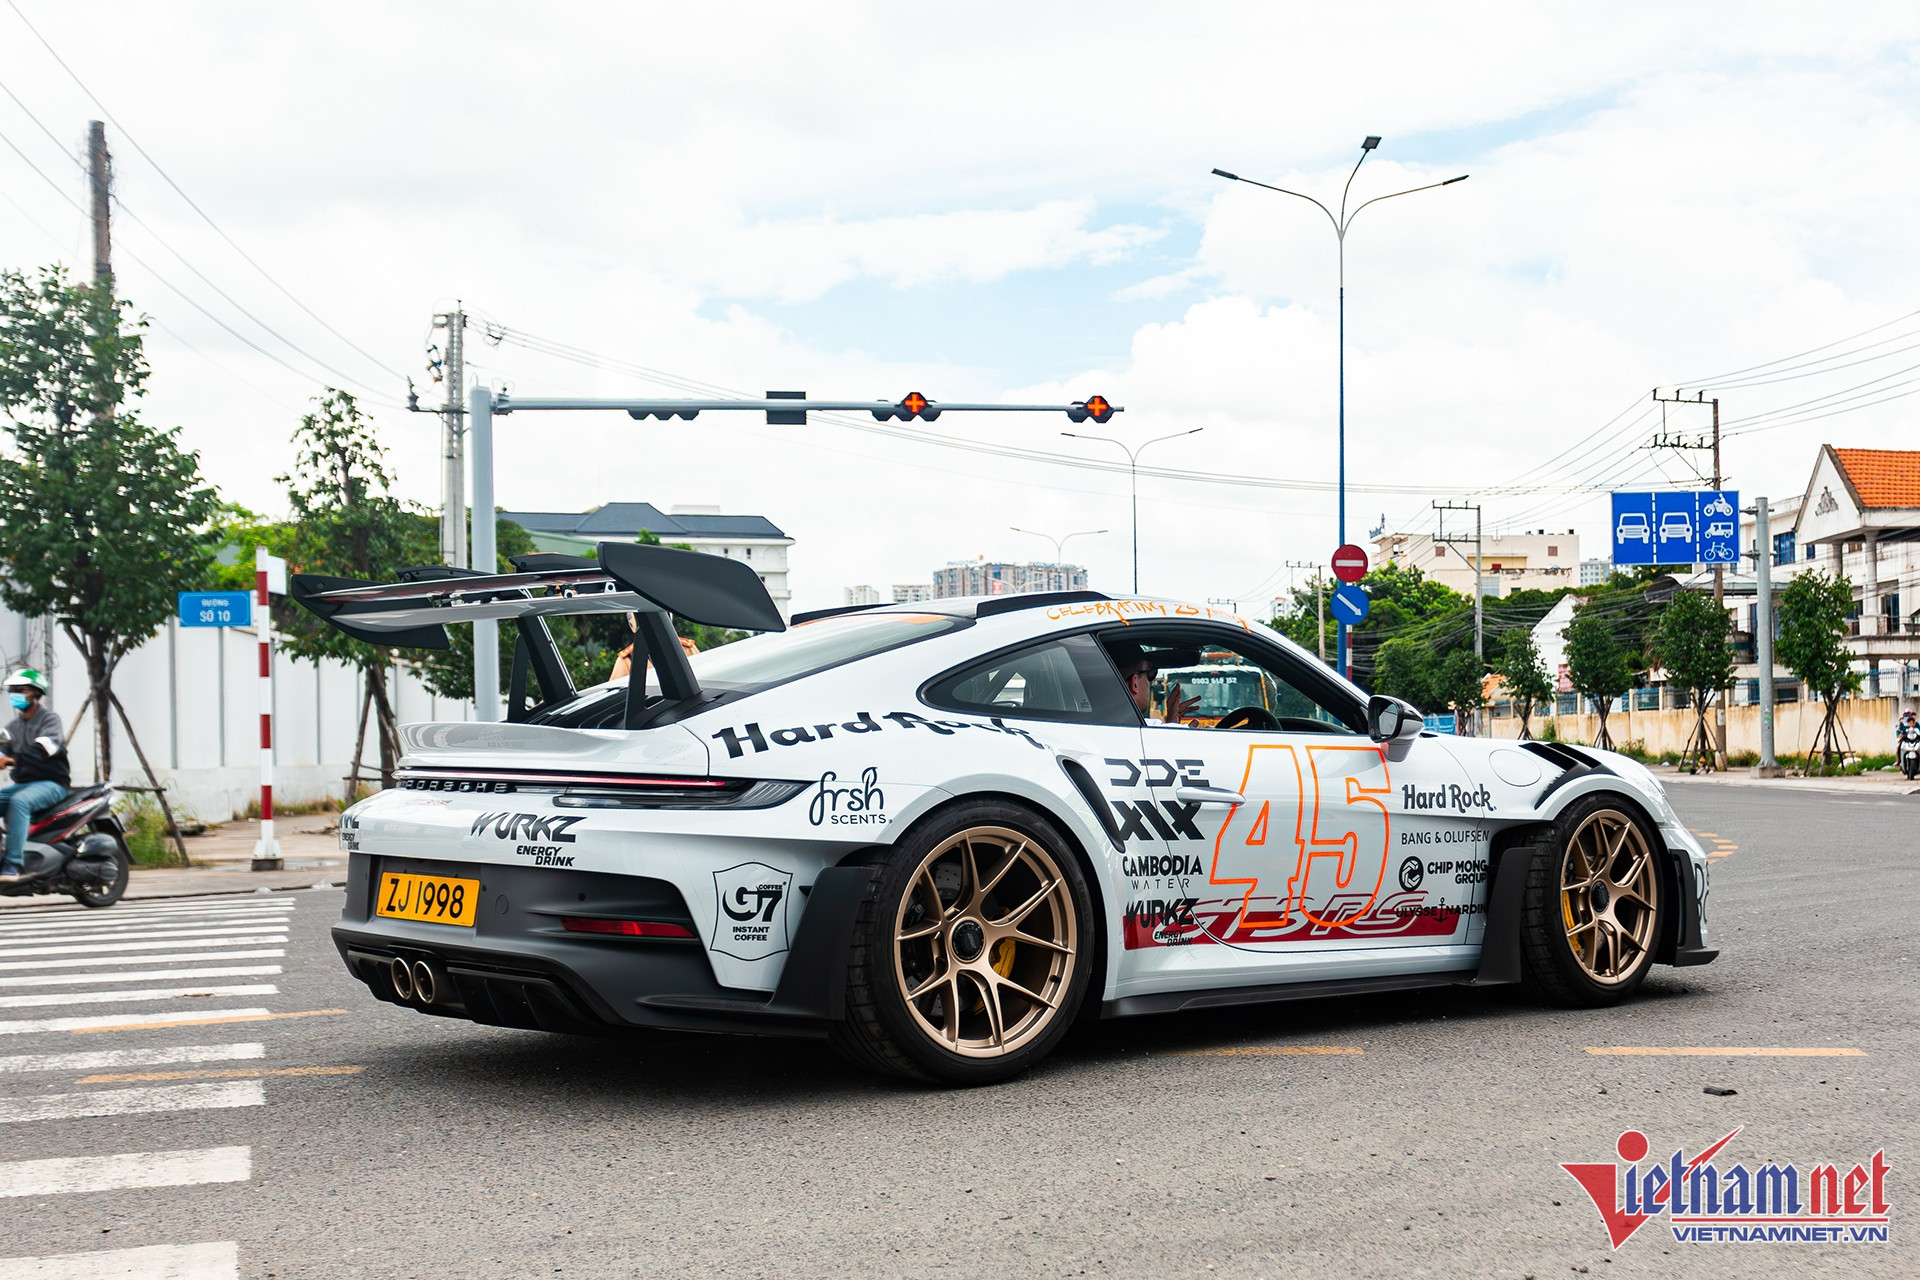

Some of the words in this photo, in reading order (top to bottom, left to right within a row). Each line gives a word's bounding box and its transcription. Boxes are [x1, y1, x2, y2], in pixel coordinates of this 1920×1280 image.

[217, 610, 231, 622] 10
[1046, 600, 1168, 627] CELEBRATING
[712, 711, 883, 759] Hard
[882, 711, 1046, 750] Rock
[405, 779, 509, 793] PORSCHE
[809, 766, 885, 826] frsh
[1401, 784, 1447, 809] Hard
[1448, 783, 1494, 813] Rock
[470, 811, 588, 842] WURKZ
[831, 814, 887, 825] SCENTS
[1209, 744, 1392, 929] 45
[1401, 832, 1431, 845] BANG
[1434, 831, 1442, 843] &
[1443, 830, 1490, 844] OLUFSEN
[516, 845, 563, 857] ENERGY
[535, 856, 576, 867] DRINK
[1122, 855, 1204, 877] CAMBODIA
[1427, 861, 1454, 875] CHIP
[1455, 859, 1487, 874] MONG
[1131, 879, 1190, 890] WATER
[1454, 872, 1487, 885] GROUP
[386, 878, 412, 912] ZJ
[414, 880, 465, 919] 1998
[722, 886, 783, 923] G7
[1125, 897, 1201, 929] WURKZ
[1395, 905, 1438, 918] ULYSSE
[1445, 903, 1487, 915] NARDIN
[1154, 930, 1184, 940] ENERGY
[1166, 937, 1193, 947] DRINK
